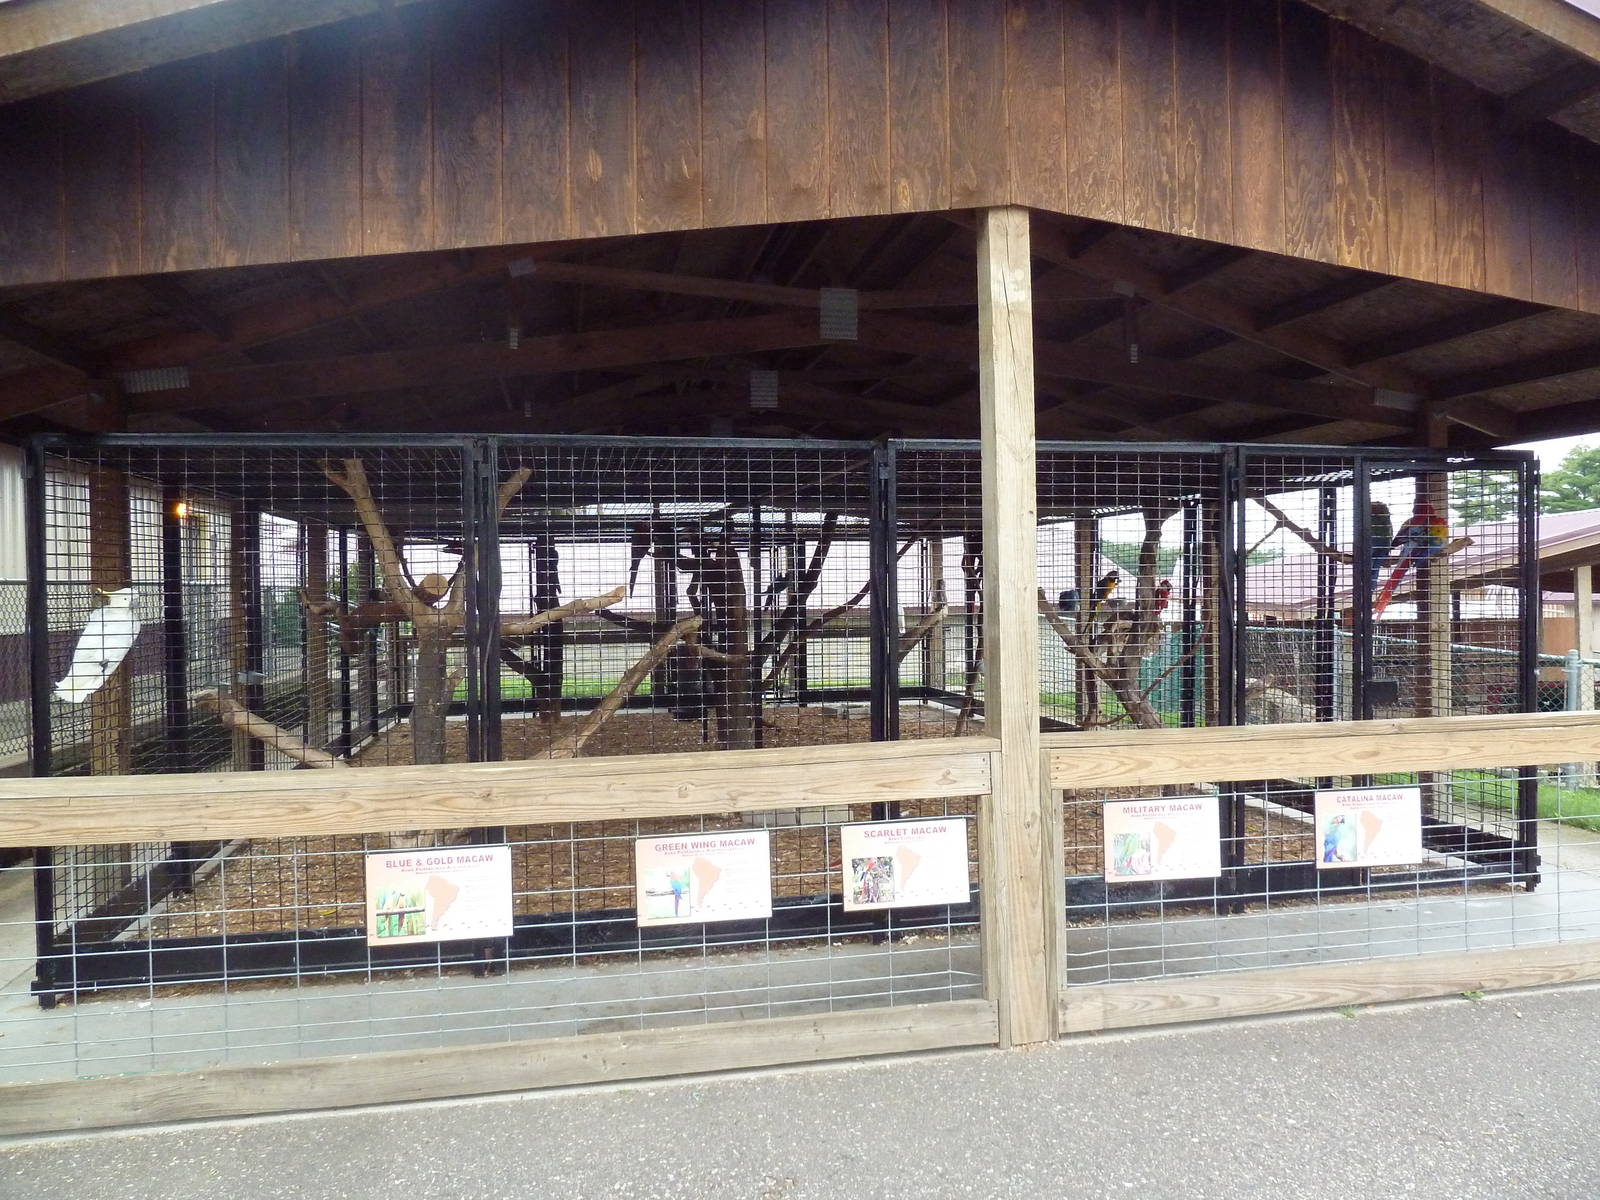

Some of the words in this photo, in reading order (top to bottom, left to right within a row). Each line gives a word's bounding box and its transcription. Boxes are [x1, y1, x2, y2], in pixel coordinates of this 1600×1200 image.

[1336, 794, 1374, 803] CATALINA
[1376, 793, 1403, 801] MACAW
[1122, 805, 1166, 814] MILITARY
[1169, 803, 1202, 812] MACAW
[863, 828, 908, 838] SCARLET
[911, 825, 947, 835] MACAW
[654, 842, 688, 852] GREEN
[690, 840, 717, 849] WING
[719, 837, 755, 847] MACAW
[385, 858, 413, 868] BLUE
[415, 858, 422, 867] &
[426, 856, 454, 866] GOLD
[456, 854, 494, 864] MACAW
